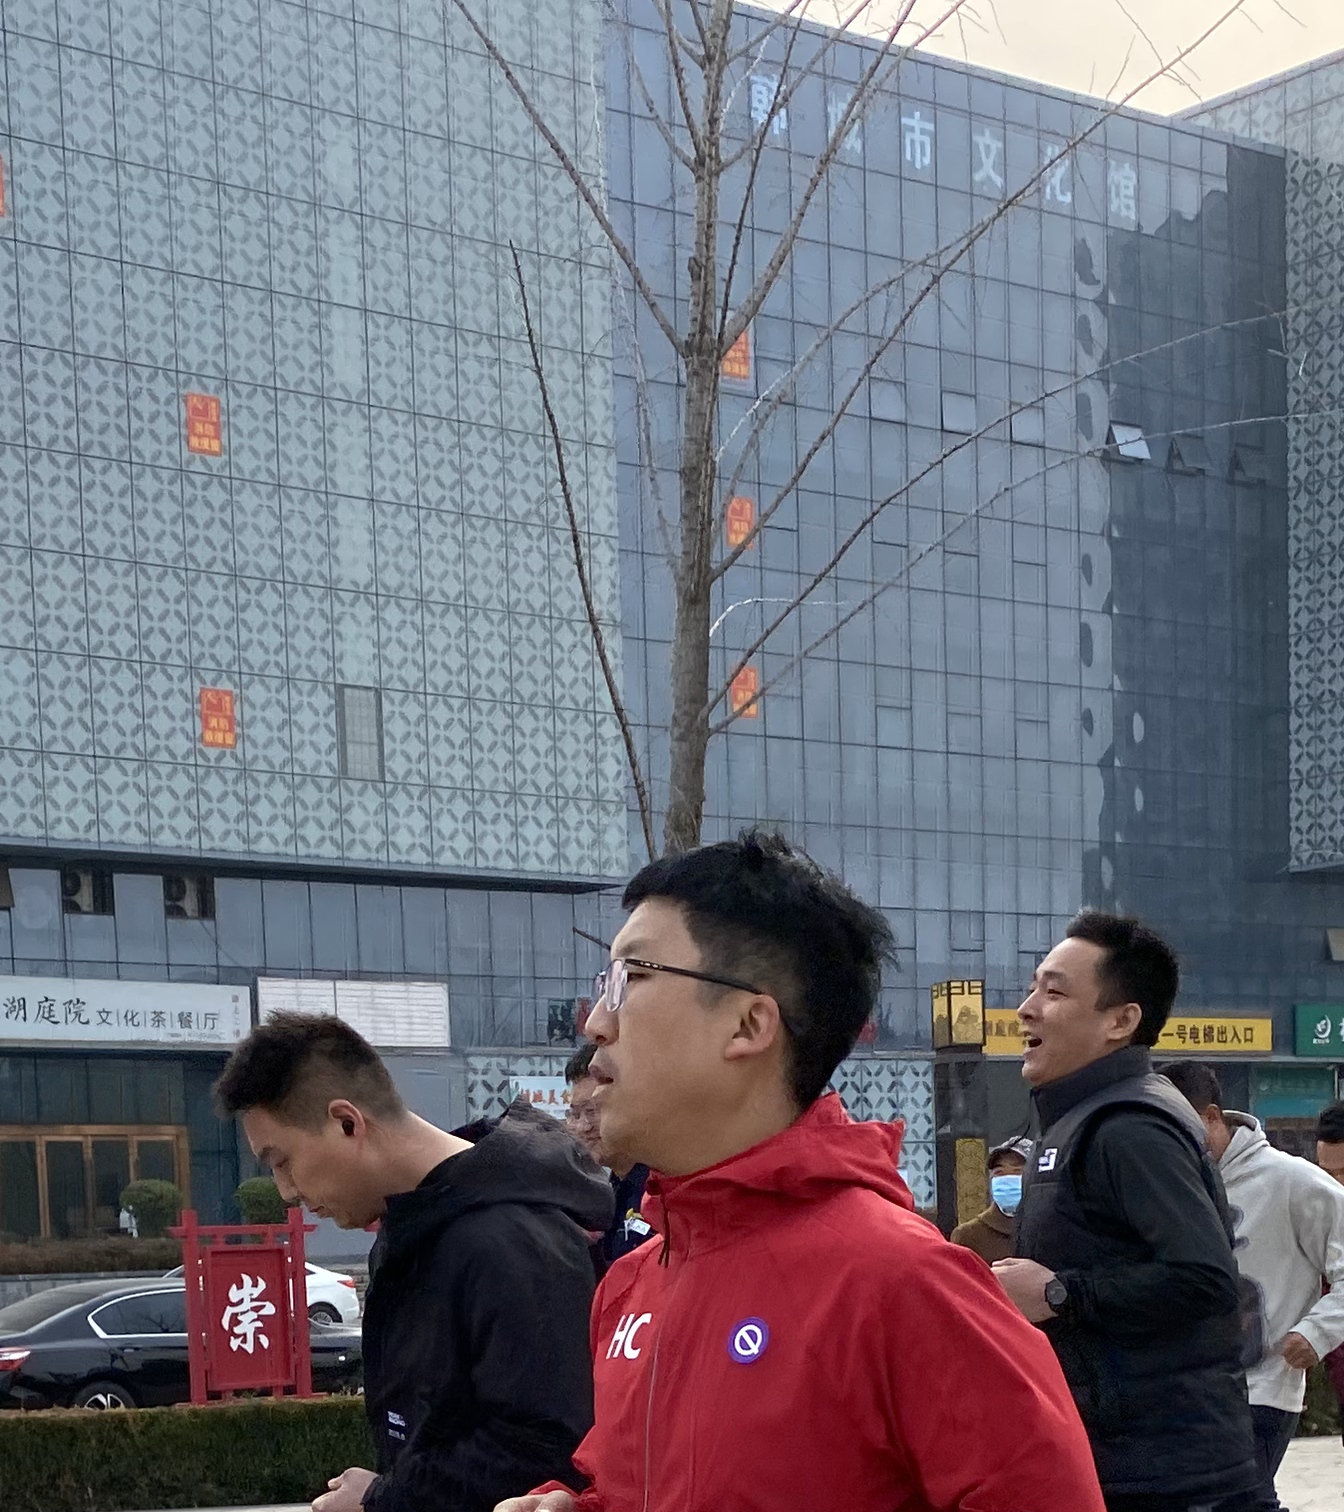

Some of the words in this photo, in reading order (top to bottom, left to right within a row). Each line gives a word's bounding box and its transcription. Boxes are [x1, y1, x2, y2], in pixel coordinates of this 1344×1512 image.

[1155, 1024, 1255, 1044] 一号电梯出入口
[221, 1273, 276, 1355] 崇
